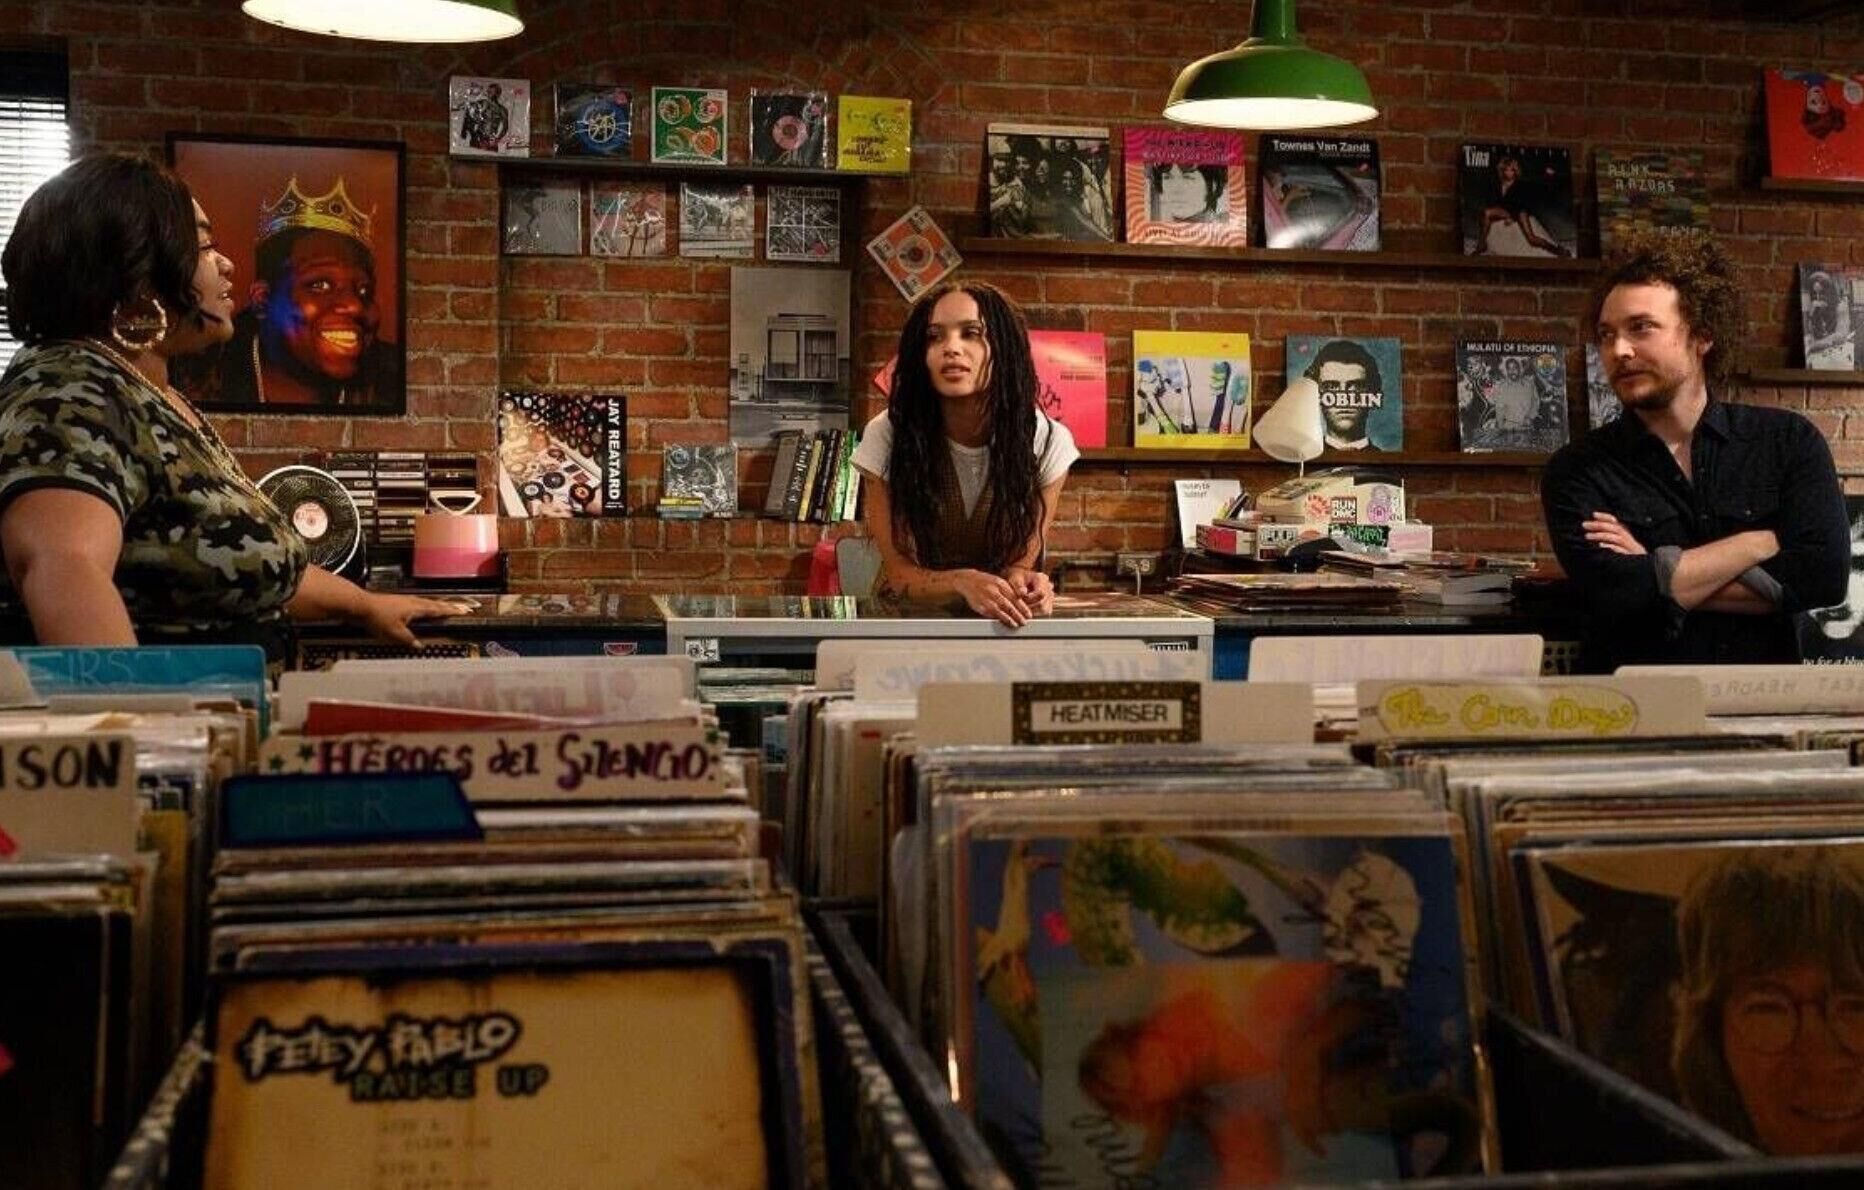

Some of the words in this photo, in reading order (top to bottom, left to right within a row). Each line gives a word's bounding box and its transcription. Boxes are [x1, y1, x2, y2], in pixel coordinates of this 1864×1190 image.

[1273, 139, 1315, 152] Townes
[1316, 141, 1338, 152] Van
[1339, 142, 1371, 153] Zandt
[1503, 343, 1514, 353] OF
[607, 398, 621, 426] JAY
[1321, 391, 1383, 408] OBLIN
[607, 429, 621, 500] REATARD
[1051, 703, 1168, 724] HEATMISER
[1385, 688, 1451, 729] The
[389, 1015, 517, 1066] PABLO
[351, 1068, 474, 1098] RAISE
[500, 1066, 548, 1096] UP
